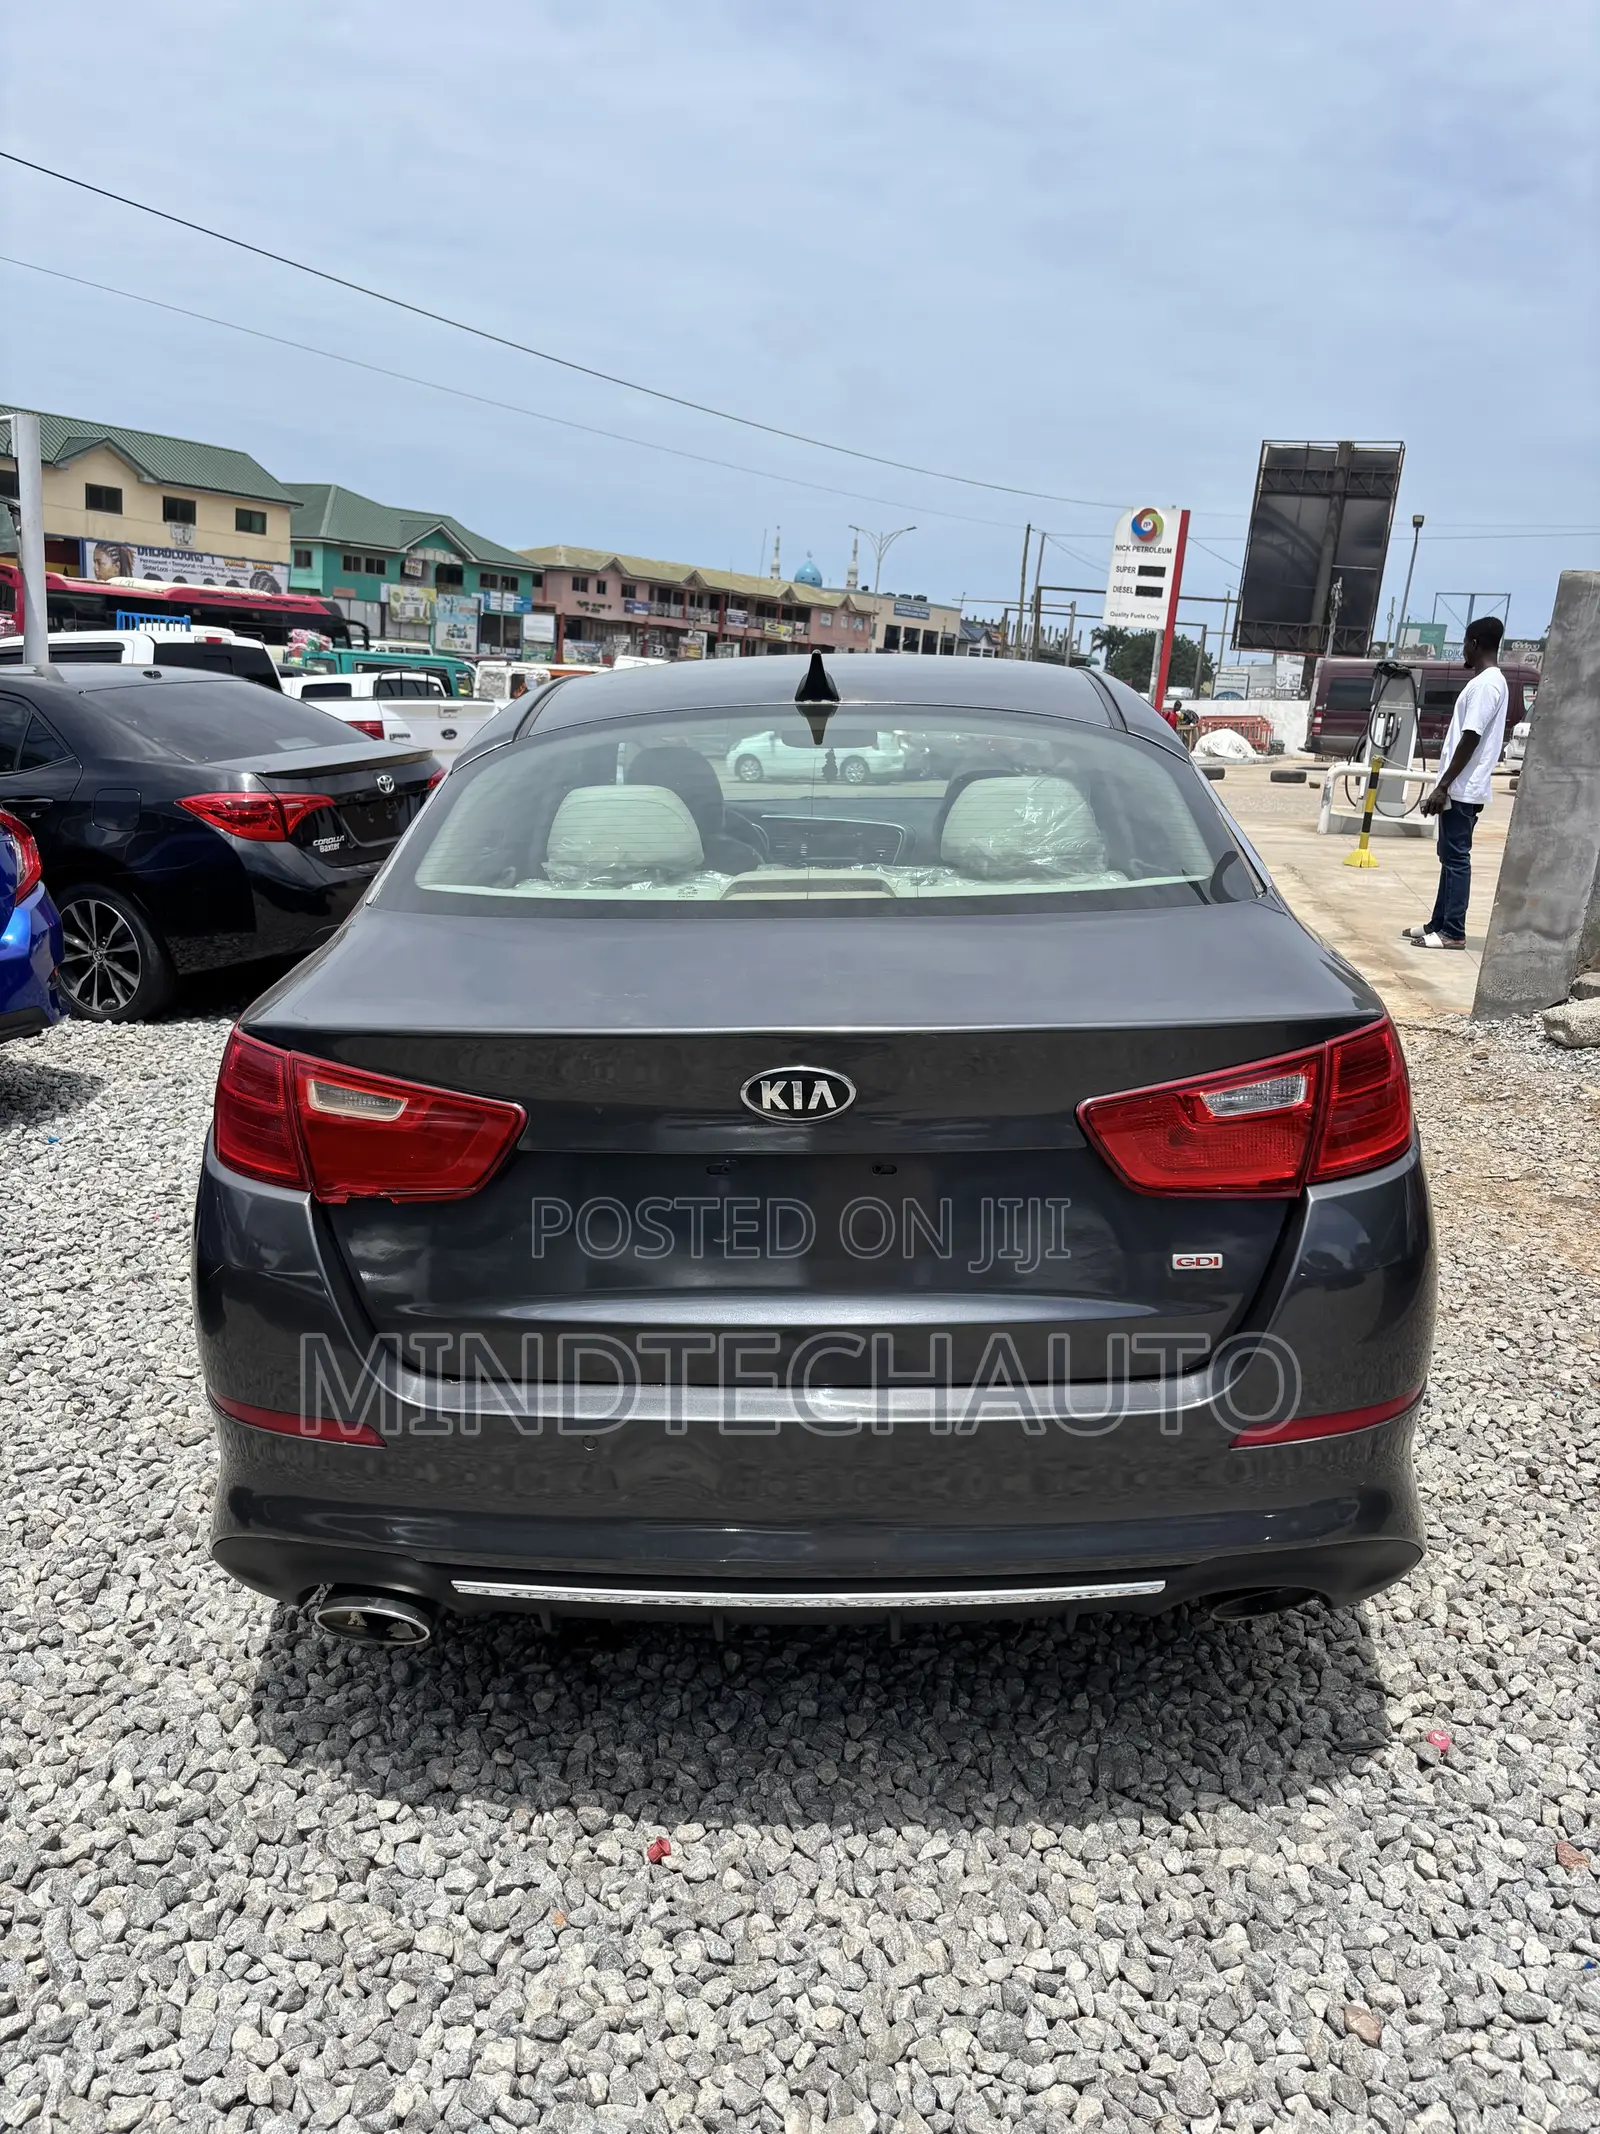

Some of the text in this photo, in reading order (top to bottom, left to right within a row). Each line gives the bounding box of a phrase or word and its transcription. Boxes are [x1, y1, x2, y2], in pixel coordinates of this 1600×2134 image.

[1132, 546, 1172, 554] PETROLEUM
[1116, 566, 1136, 574] SUPER
[1113, 585, 1134, 594] DIESEL
[1110, 611, 1130, 619] Quality
[1147, 613, 1160, 621] Only
[313, 835, 345, 847] COROLLA
[319, 843, 340, 853] Baxter
[760, 1081, 837, 1110] KIA
[1176, 1257, 1219, 1267] GDI
